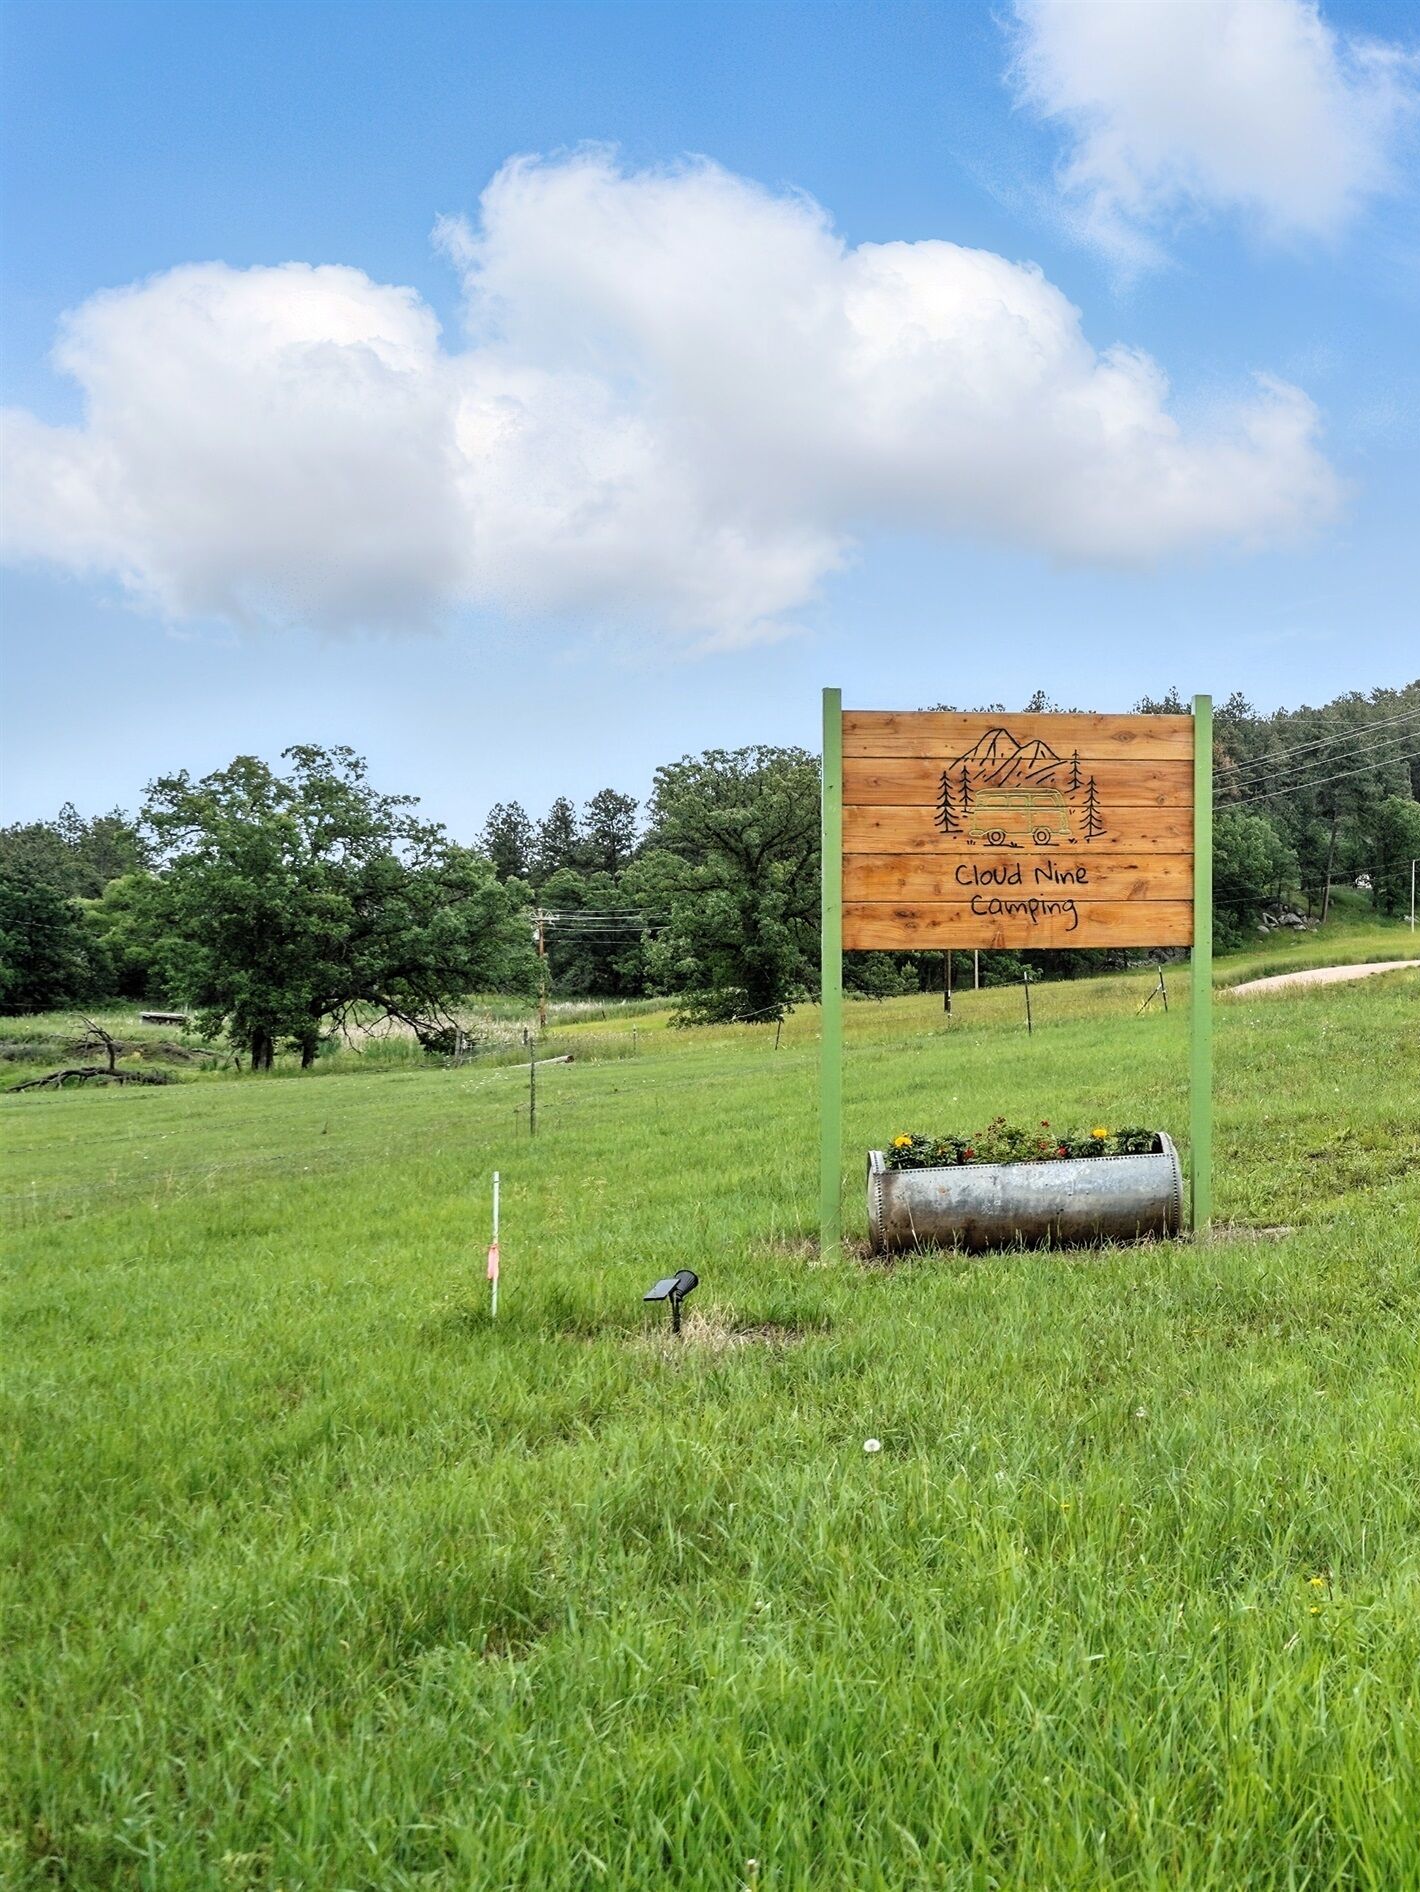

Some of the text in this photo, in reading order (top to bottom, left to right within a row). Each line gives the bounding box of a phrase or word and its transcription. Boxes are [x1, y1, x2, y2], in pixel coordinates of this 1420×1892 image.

[955, 860, 1089, 886] Cloud Nine
[971, 893, 1079, 932] Camping
